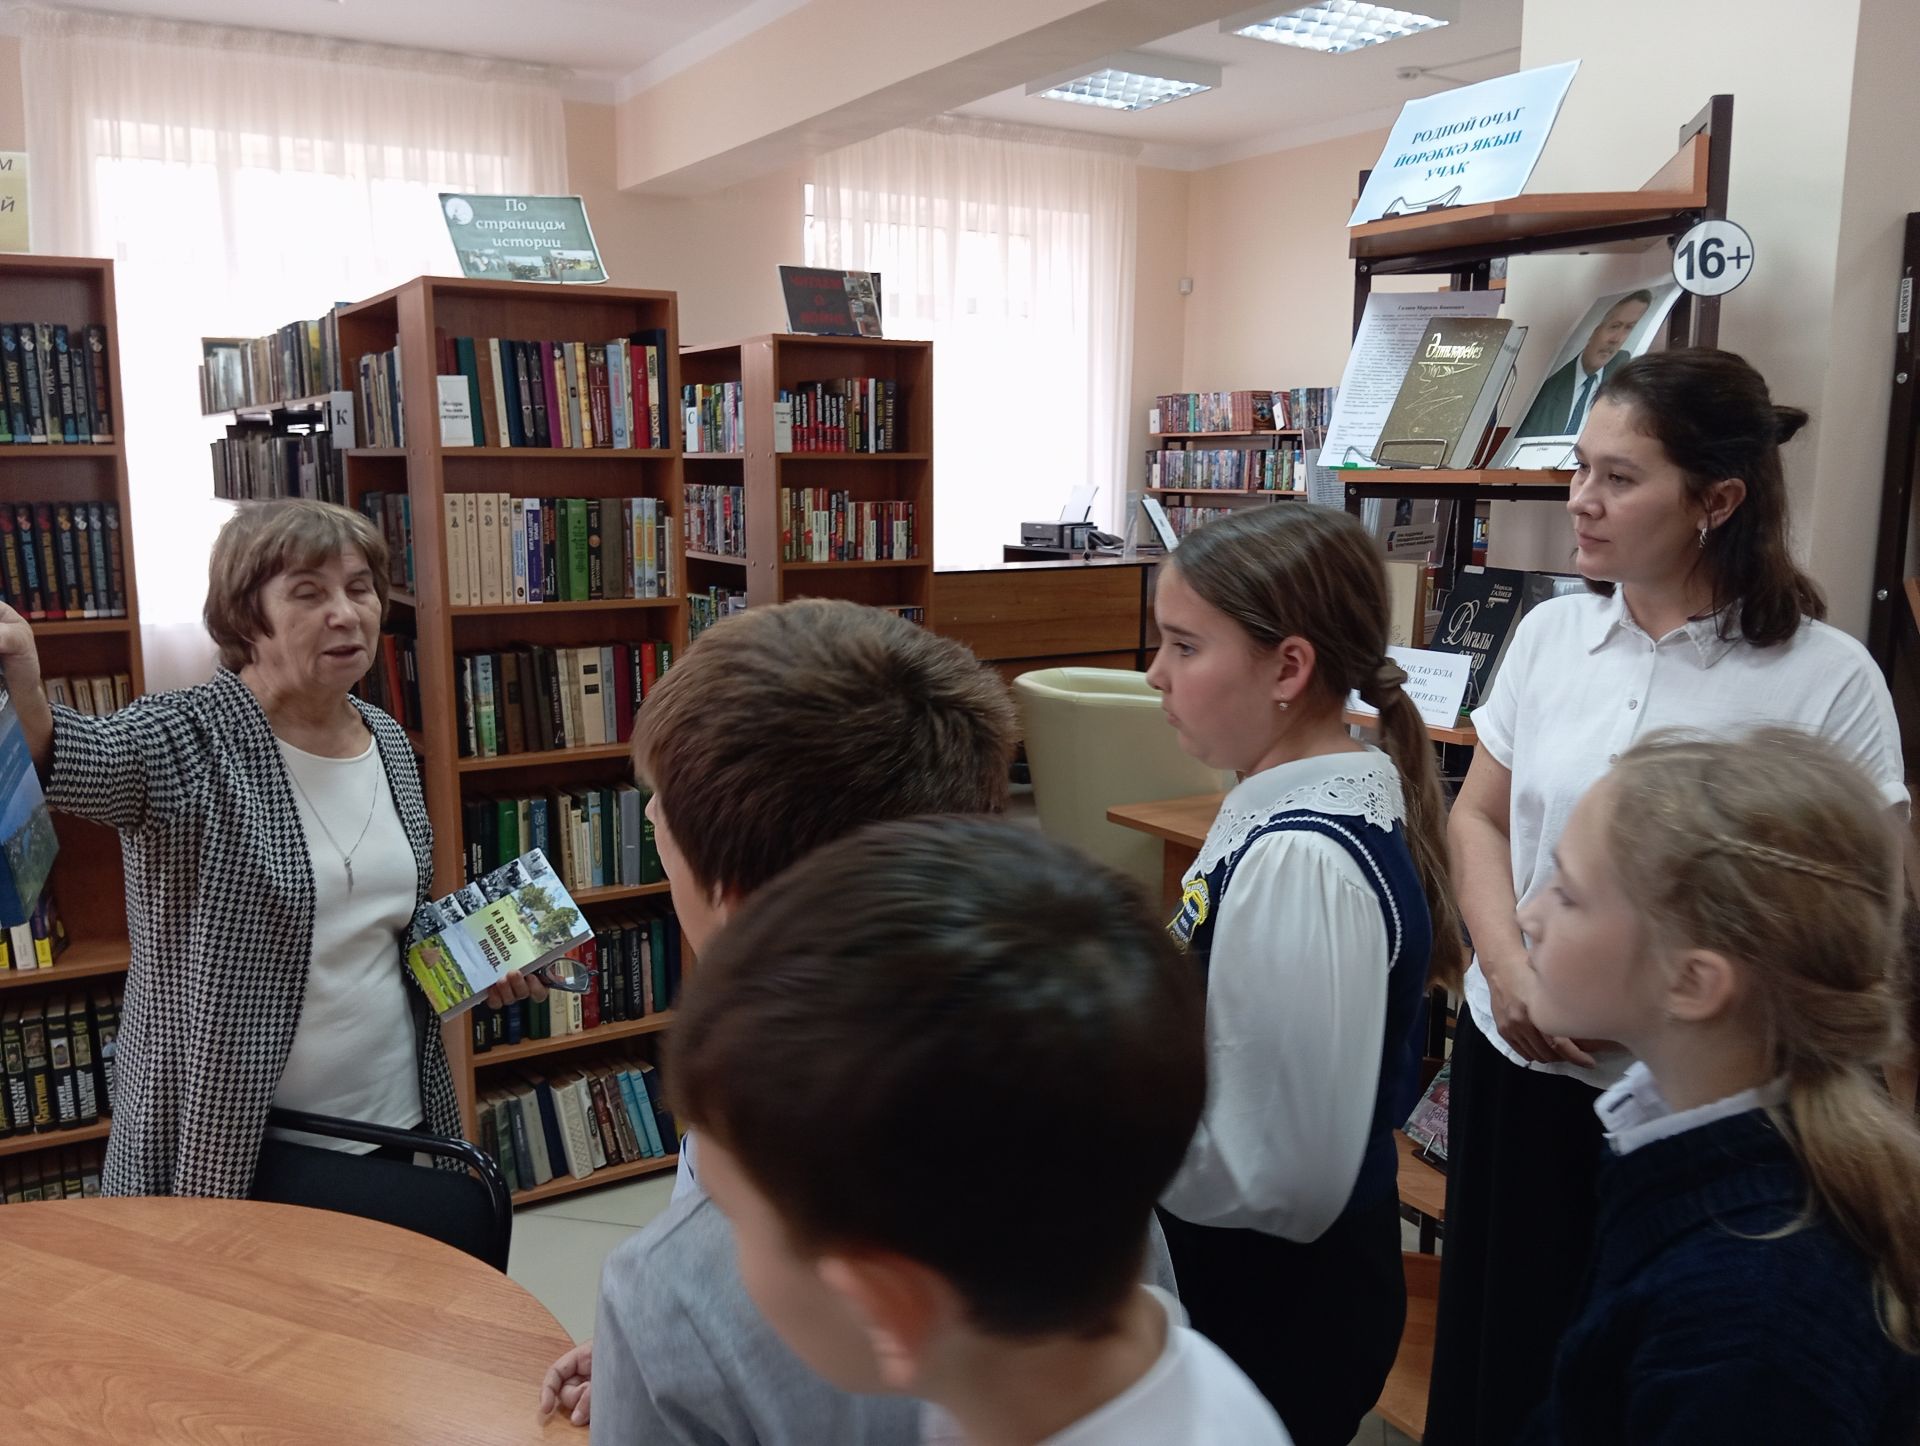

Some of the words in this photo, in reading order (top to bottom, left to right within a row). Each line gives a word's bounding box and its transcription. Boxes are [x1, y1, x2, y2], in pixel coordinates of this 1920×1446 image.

[1412, 116, 1477, 145] РОДНОЙ
[1479, 106, 1526, 129] ОЧАГ
[1469, 130, 1523, 152] ЯКЫН
[1424, 160, 1470, 181] УЧАК
[505, 198, 527, 212] По
[475, 219, 567, 233] страницам
[492, 238, 562, 250] истории
[1677, 237, 1751, 281] 16+
[336, 409, 348, 425] К
[688, 411, 695, 424] С
[1490, 589, 1513, 598] ГАЛИЕВ
[1441, 599, 1494, 651] Догалы
[491, 909, 500, 918] И
[495, 915, 504, 924] В
[500, 922, 518, 946] ТЫЛУ
[484, 924, 512, 963] КОВАЛАСЬ
